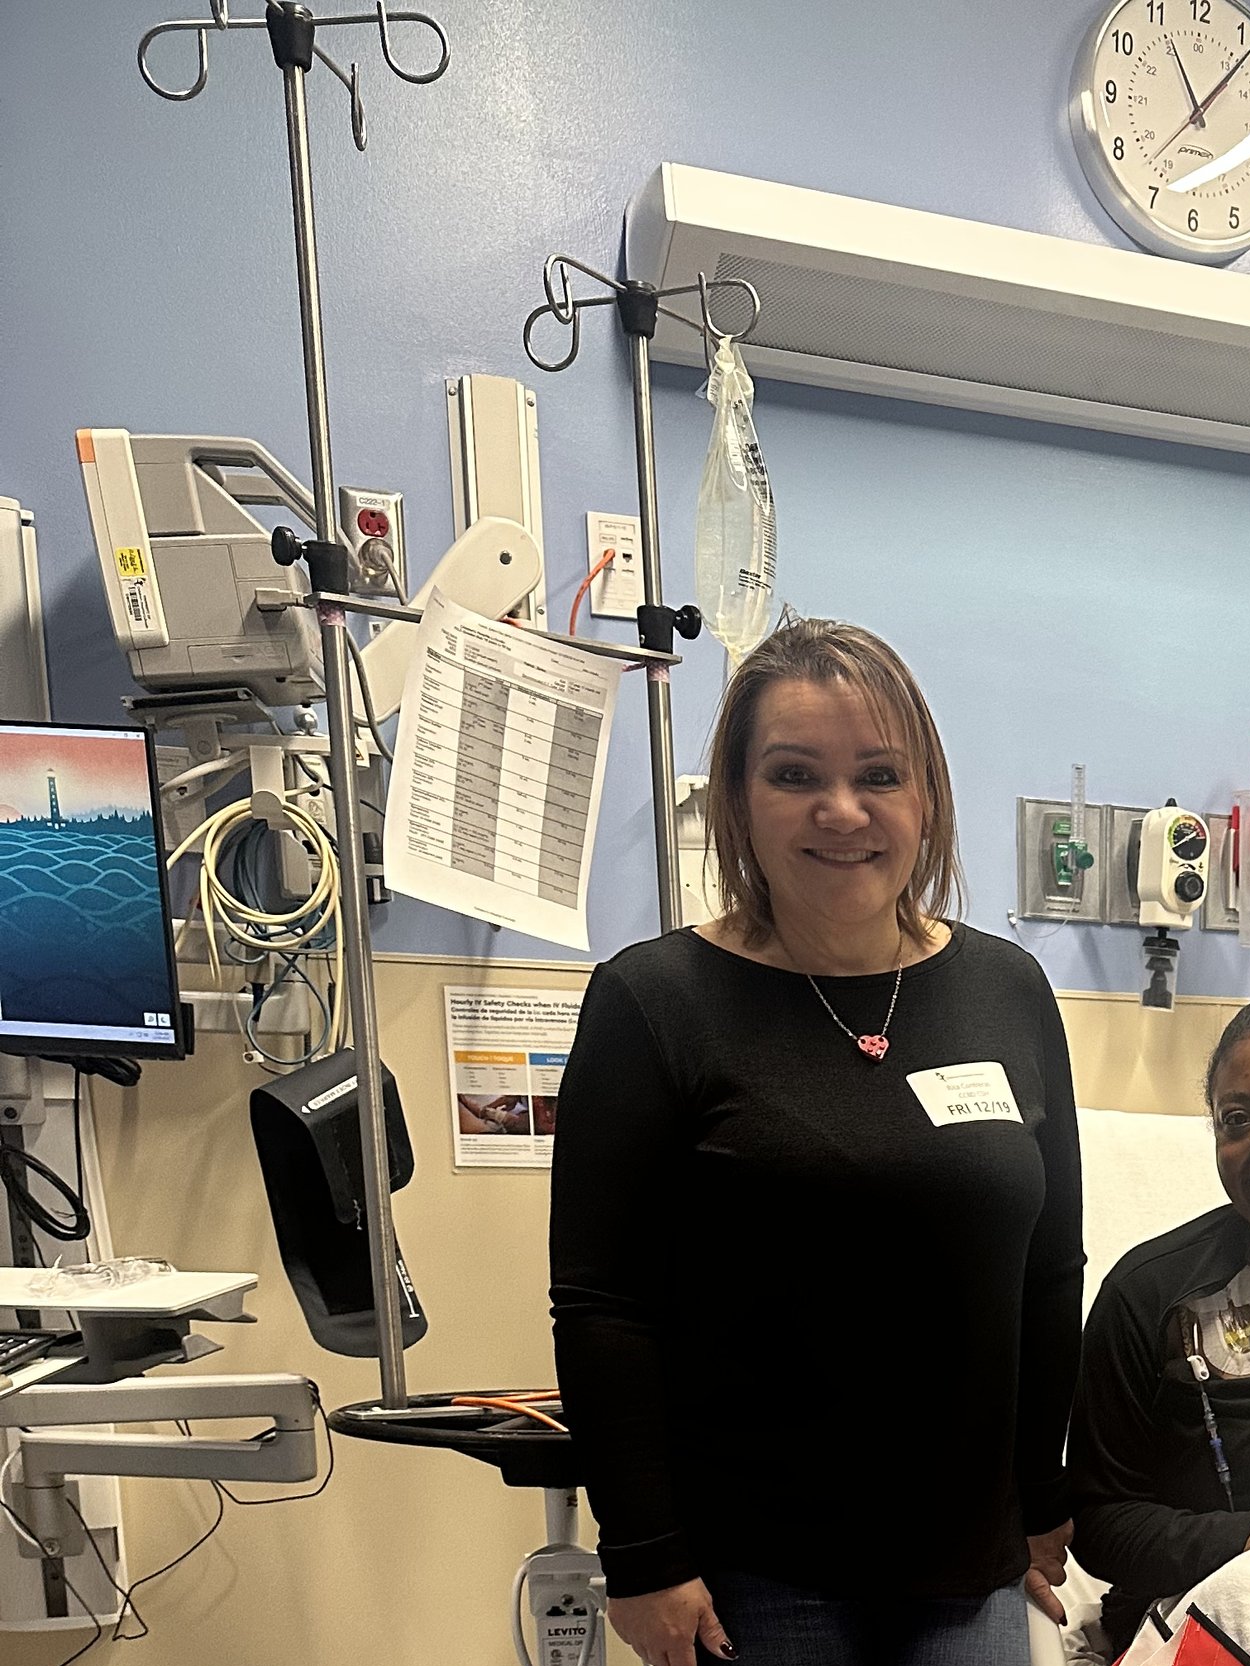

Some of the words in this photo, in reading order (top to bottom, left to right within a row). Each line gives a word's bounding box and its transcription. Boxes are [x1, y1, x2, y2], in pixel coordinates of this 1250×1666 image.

[1146, 1, 1164, 26] 11
[1190, 0, 1211, 24] 12
[1111, 29, 1133, 56] 10
[1237, 22, 1245, 45] 1
[1105, 80, 1117, 104] 9
[1113, 136, 1124, 161] 8
[1148, 185, 1160, 210] 7
[1187, 208, 1199, 232] 6
[1228, 206, 1240, 230] 5
[946, 1103, 972, 1116] FRI
[974, 1101, 1011, 1114] 12/19
[548, 1627, 586, 1637] LEVITO
